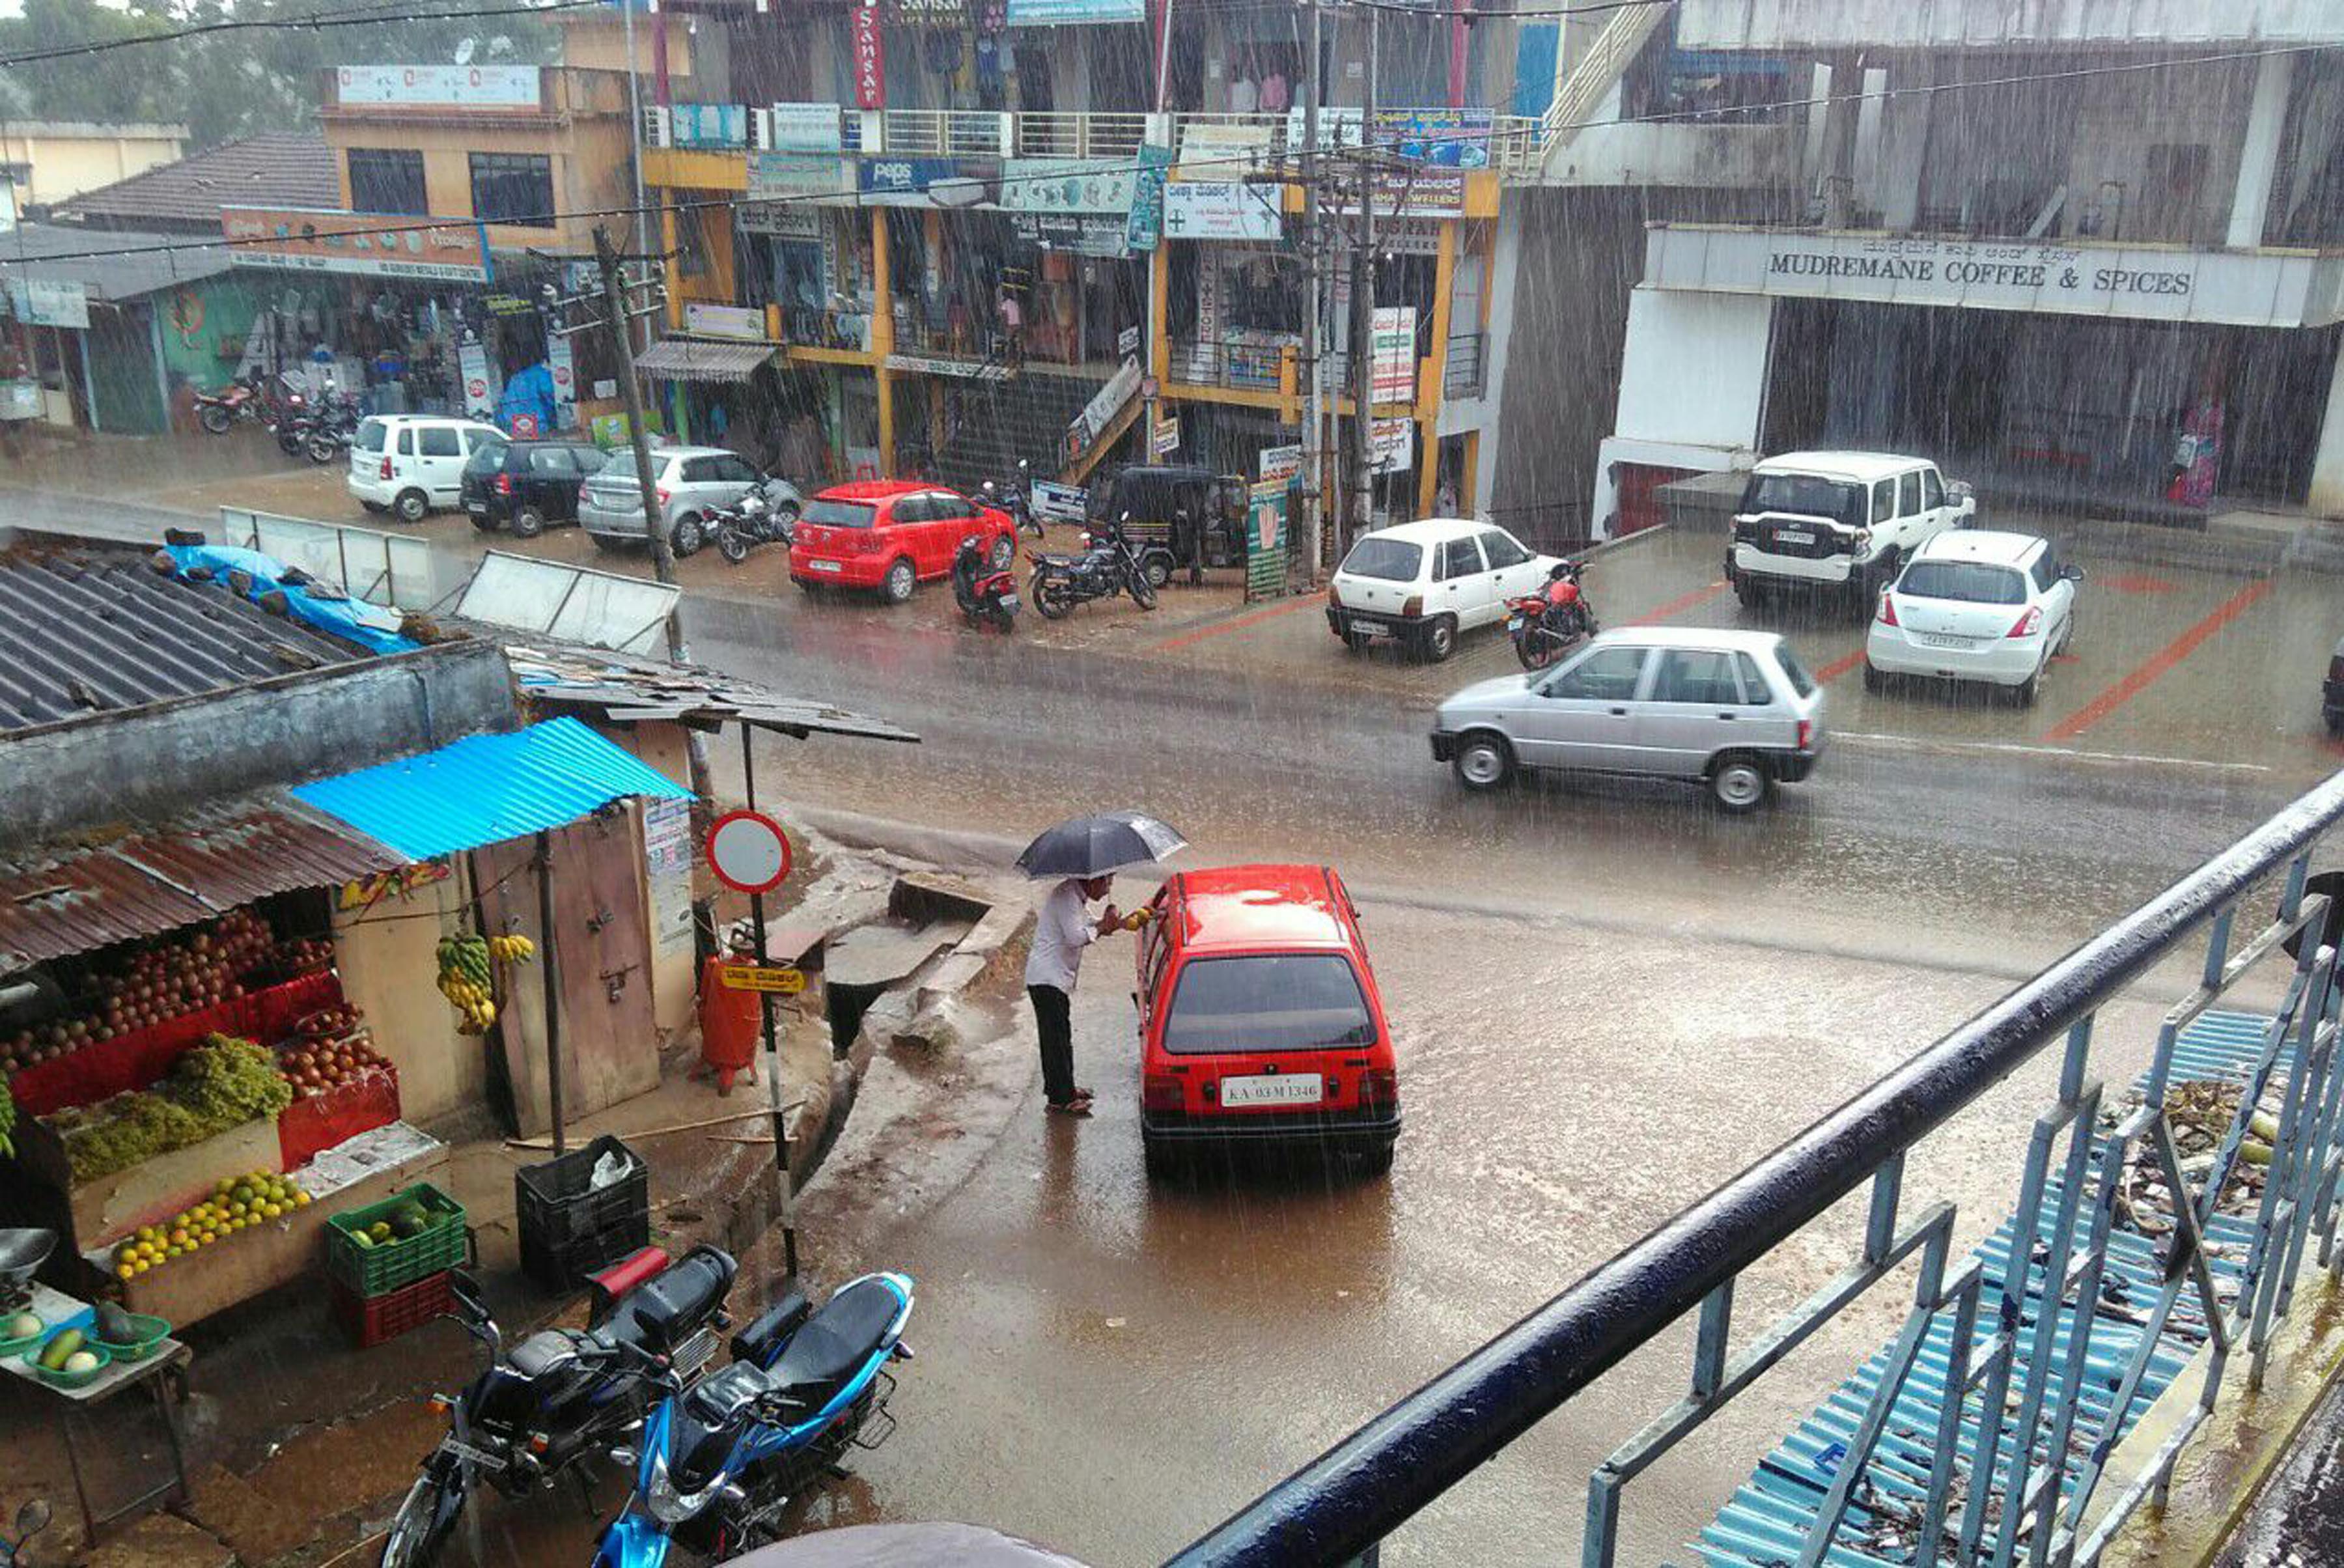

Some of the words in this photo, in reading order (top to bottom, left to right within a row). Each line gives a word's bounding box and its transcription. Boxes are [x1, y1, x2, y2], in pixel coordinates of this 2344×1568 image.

[1770, 253, 1934, 281] MUDREMANE
[1946, 260, 2046, 287] COFFEE
[2059, 266, 2080, 288] &
[2093, 268, 2192, 296] SPICES
[1230, 1088, 1249, 1099] KA
[1289, 1085, 1318, 1097] 1346
